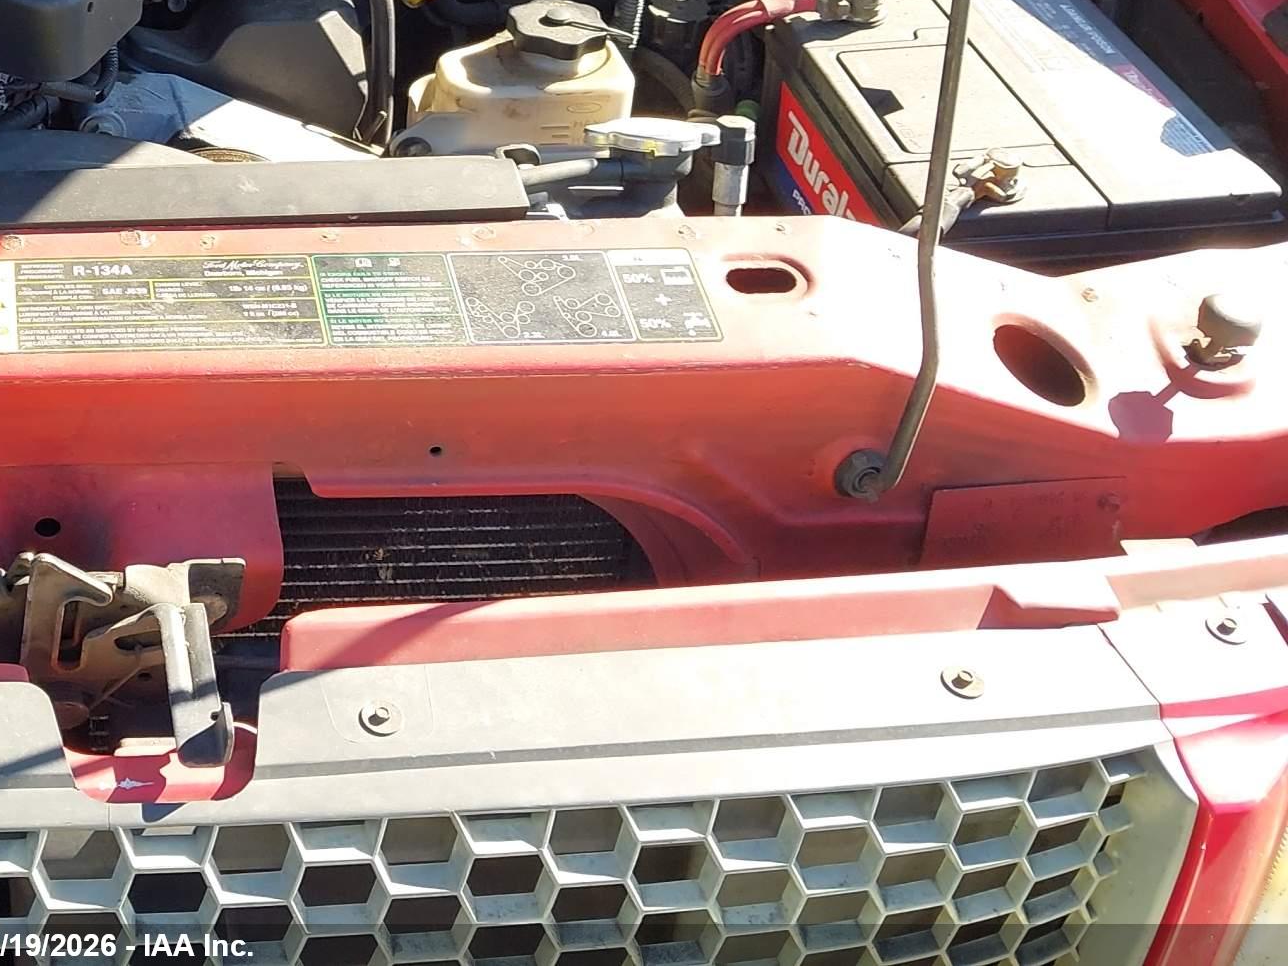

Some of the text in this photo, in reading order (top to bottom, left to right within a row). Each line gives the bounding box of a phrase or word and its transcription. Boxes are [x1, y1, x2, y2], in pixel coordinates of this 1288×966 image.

[788, 110, 857, 222] Dural
[72, 264, 133, 276] R-134A
[622, 273, 654, 284] 50%
[639, 318, 672, 329] 50%
